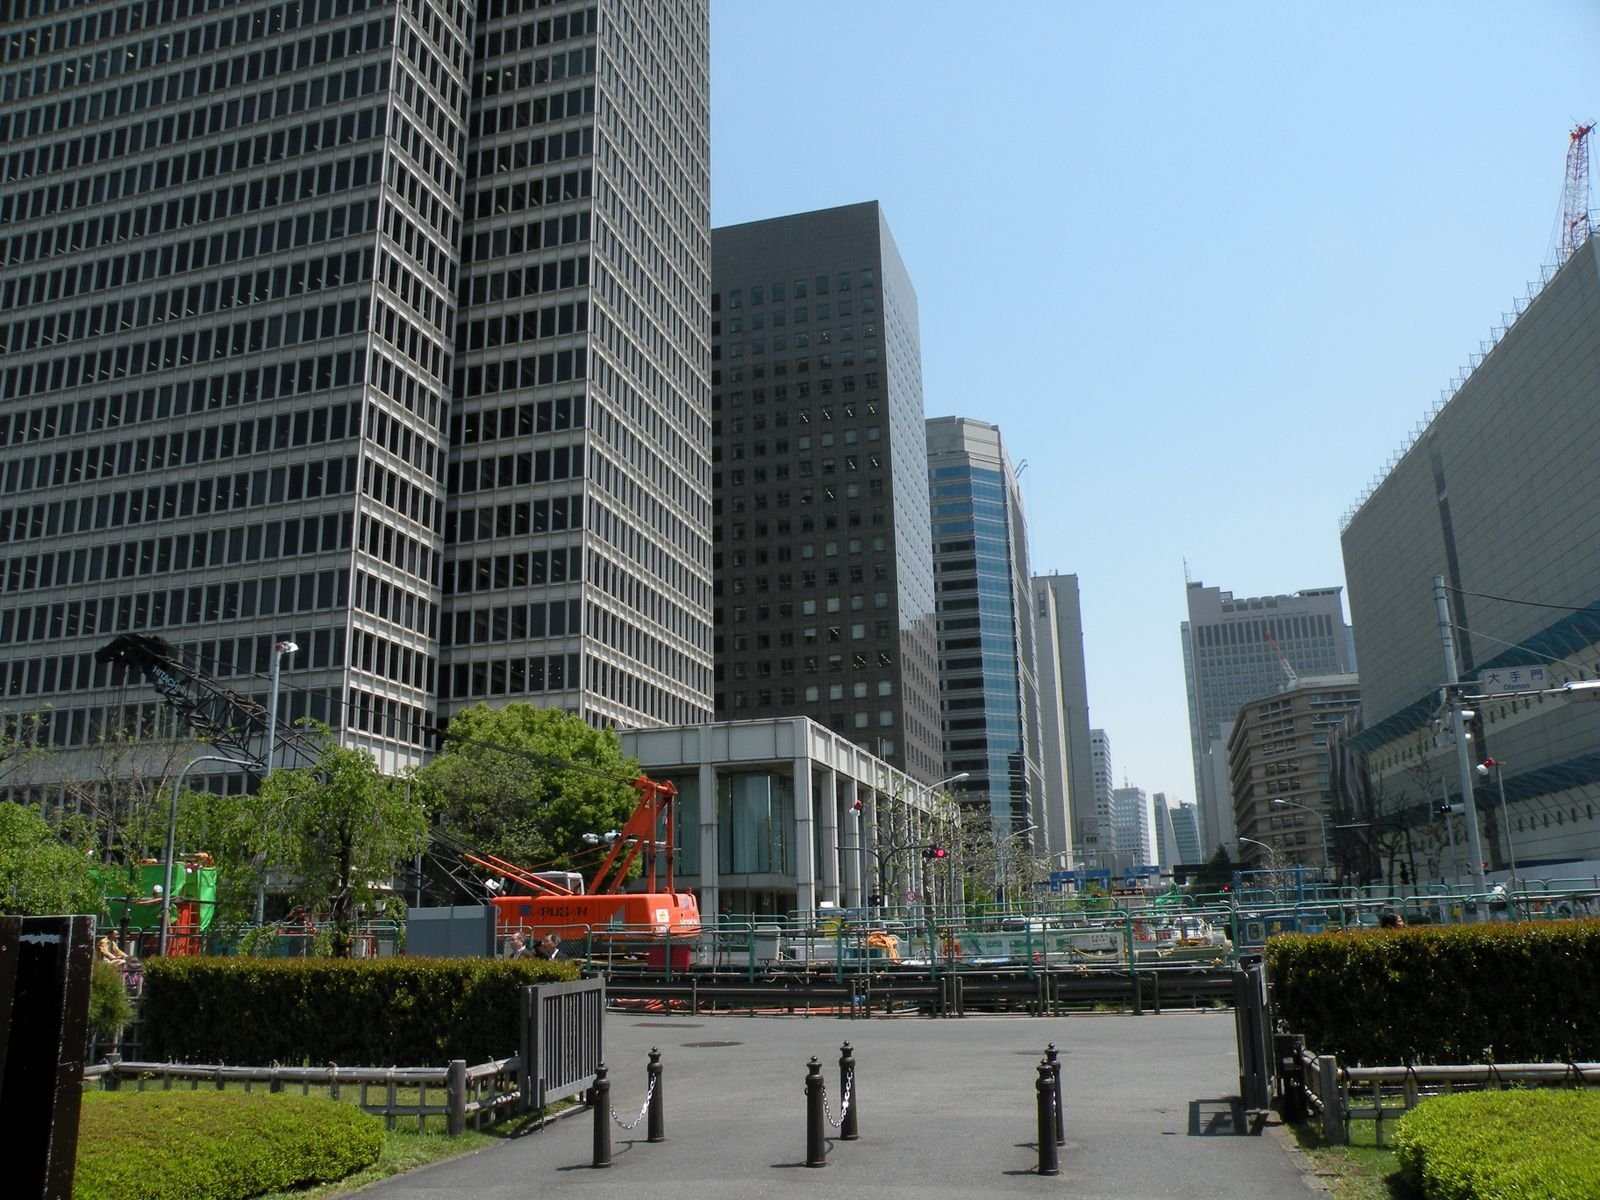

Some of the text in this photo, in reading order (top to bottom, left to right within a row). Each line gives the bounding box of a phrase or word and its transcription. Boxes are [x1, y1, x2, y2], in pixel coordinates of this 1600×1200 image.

[151, 665, 181, 691] HITACHI
[1488, 669, 1543, 684] 大手門
